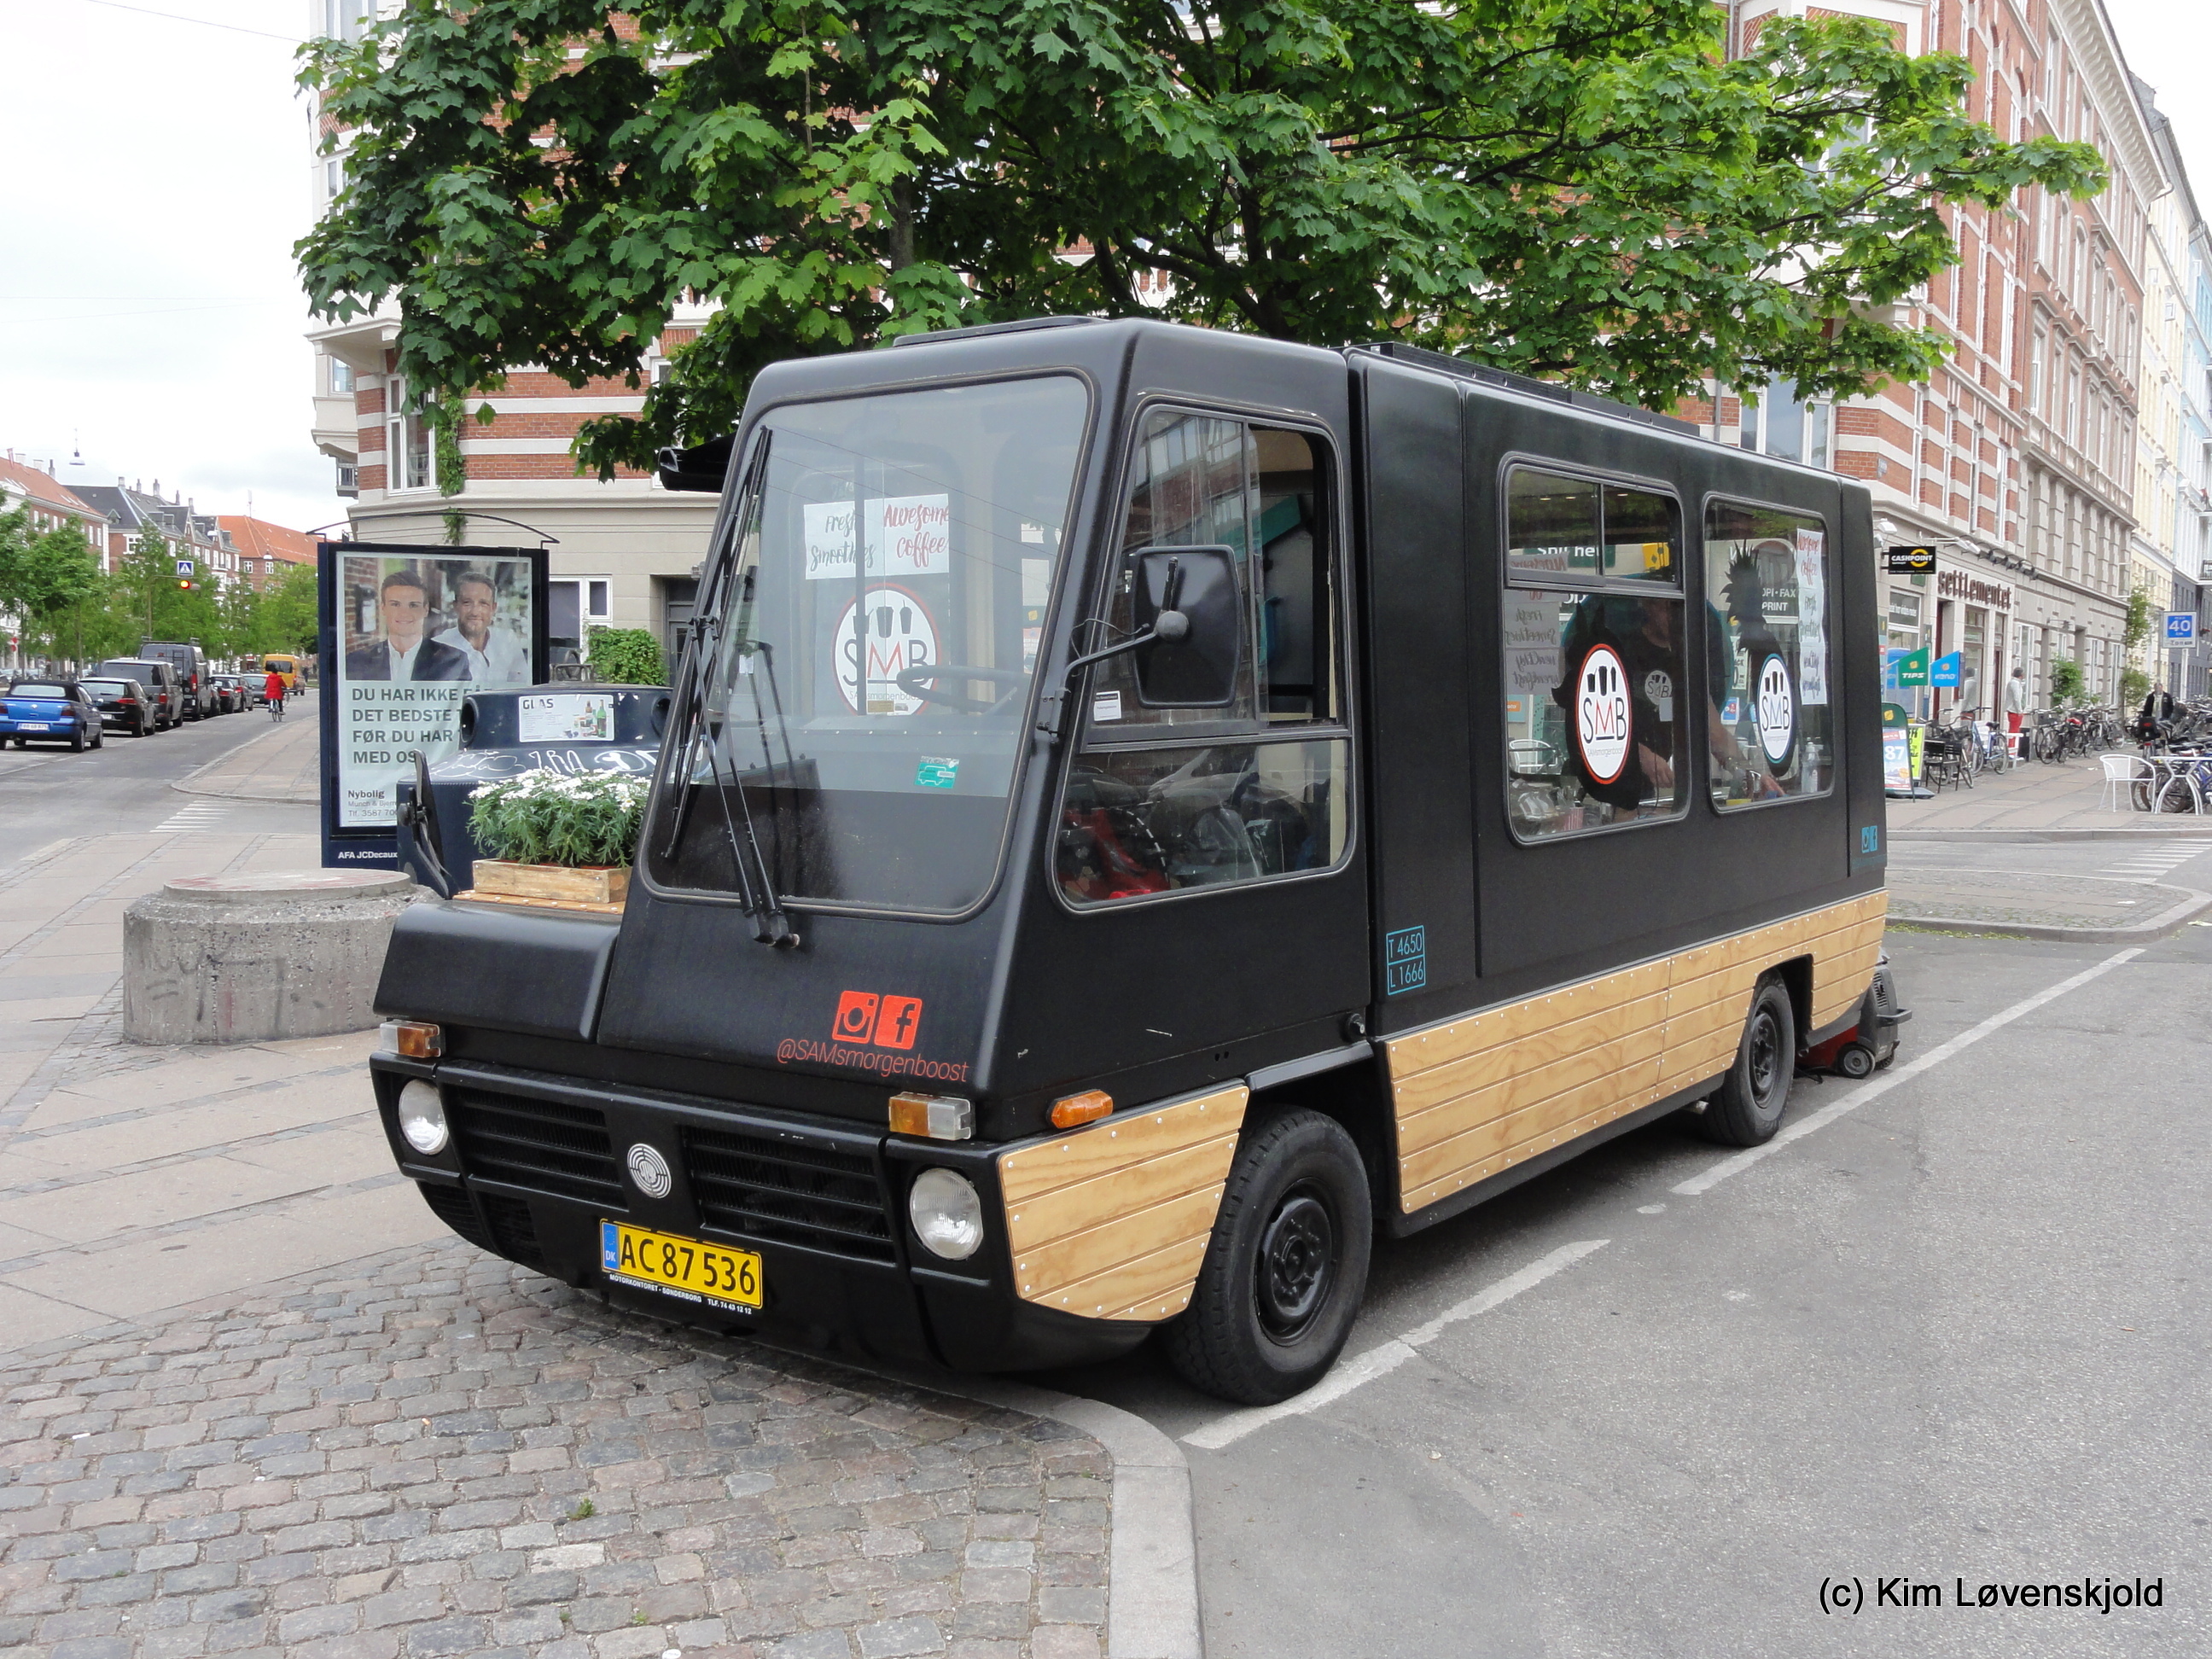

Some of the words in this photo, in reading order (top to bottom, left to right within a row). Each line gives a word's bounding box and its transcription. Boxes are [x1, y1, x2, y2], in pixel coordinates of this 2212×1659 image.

[811, 540, 876, 572] Smoothes
[1779, 589, 1796, 597] FAX
[1761, 602, 1788, 611] PRINT
[2168, 620, 2191, 632] 40
[352, 688, 375, 701] DU
[381, 688, 416, 701] HAR
[421, 688, 458, 701] IKKE
[352, 709, 383, 722] DET
[388, 709, 452, 722] BEDSTE
[1583, 697, 1627, 744] SMB
[1761, 696, 1790, 732] SMB
[352, 730, 386, 743] FØR
[392, 730, 415, 742] DU
[421, 730, 453, 742] HAR
[353, 751, 391, 764] MED
[396, 751, 416, 764] OS
[1884, 746, 1905, 760] 87
[347, 789, 385, 800] Nybolig
[357, 851, 398, 859] JCDecaux
[1388, 939, 1394, 958] T
[1397, 932, 1423, 956] 4650
[1390, 969, 1396, 988] L
[1400, 960, 1423, 986] 1666
[777, 1038, 970, 1083] @SAMsmorgenboost
[605, 1249, 616, 1262] DK
[620, 1233, 655, 1273] AC
[662, 1242, 695, 1282] 87
[703, 1251, 755, 1295] 536
[609, 1273, 658, 1292] MOTORKONTORET
[707, 1298, 720, 1307] TLF.
[736, 1305, 744, 1313] 12
